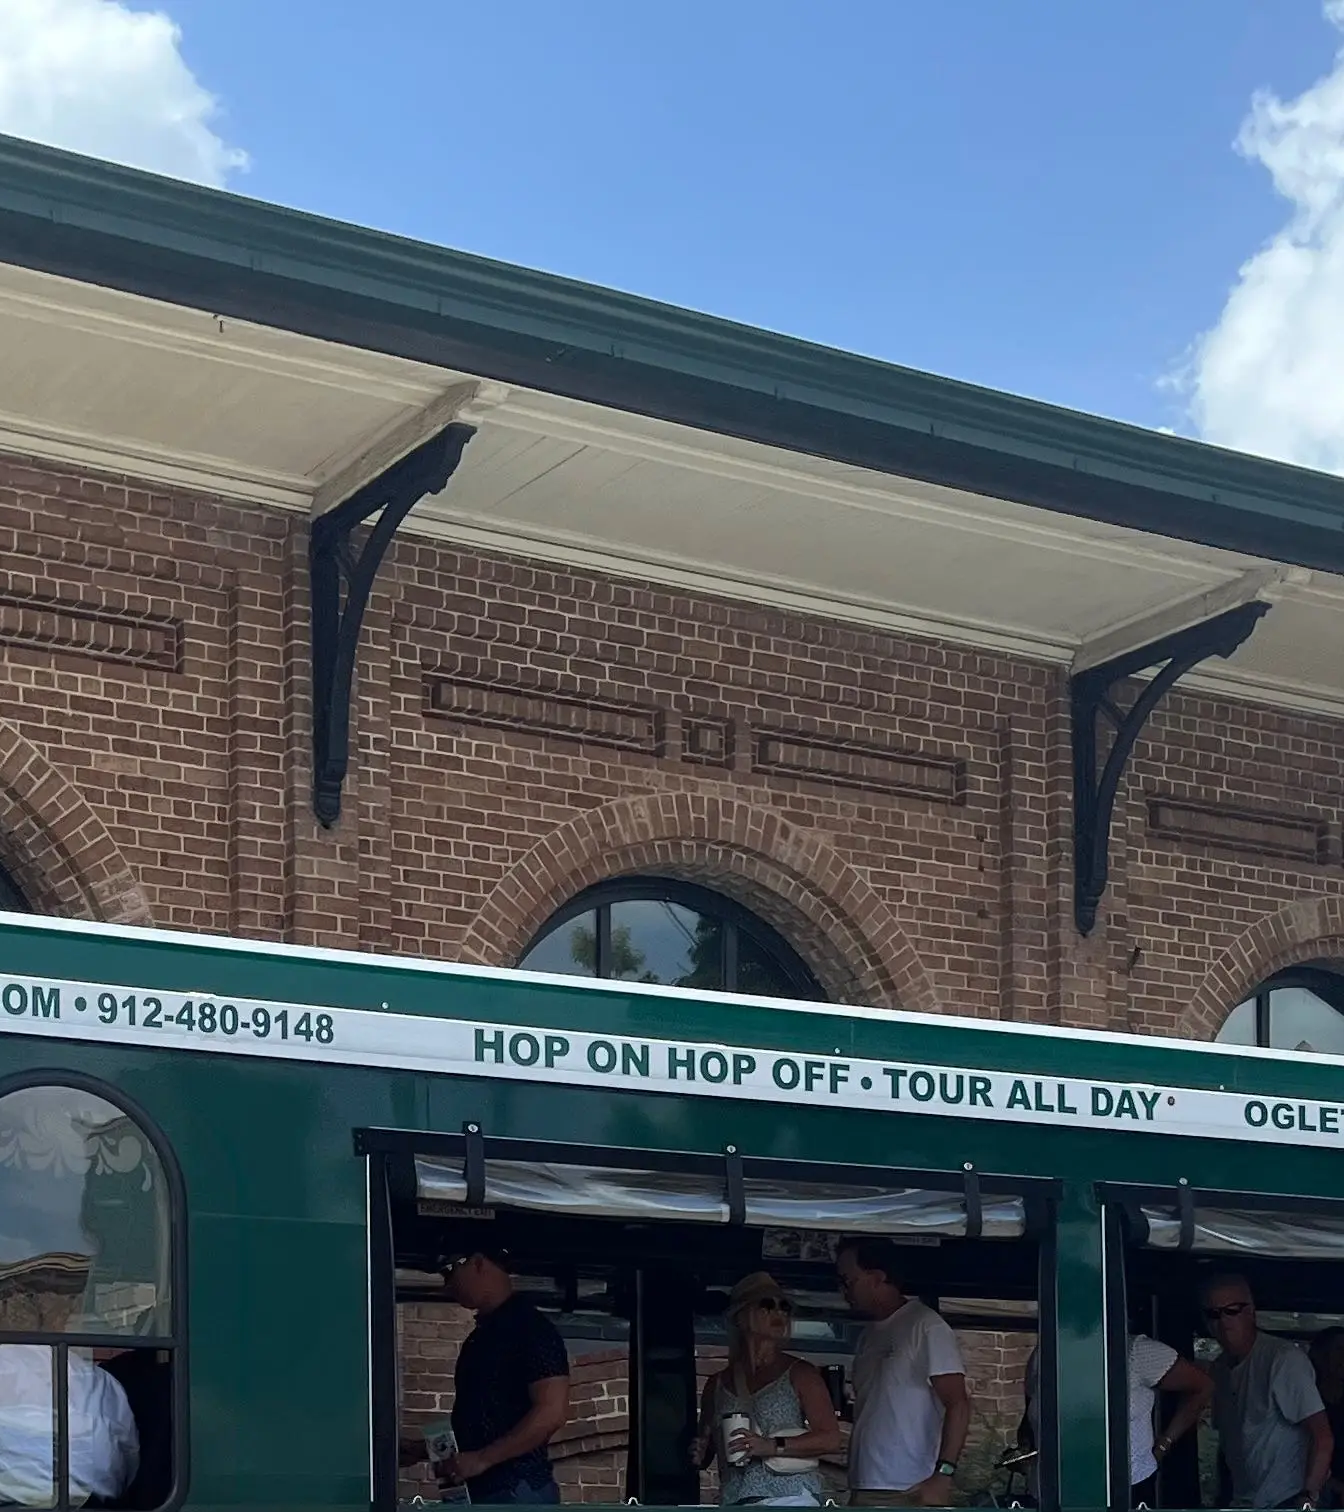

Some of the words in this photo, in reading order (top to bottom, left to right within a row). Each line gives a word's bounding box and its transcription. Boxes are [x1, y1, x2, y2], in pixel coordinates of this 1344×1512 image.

[97, 993, 335, 1045] 912-480-9148
[474, 1028, 570, 1067] HOP
[587, 1040, 651, 1077] ON
[667, 1047, 757, 1085] HOP
[772, 1057, 851, 1095] OFF
[883, 1067, 993, 1109] TOUR
[1005, 1078, 1078, 1115] ALL
[1090, 1086, 1162, 1121] DAY
